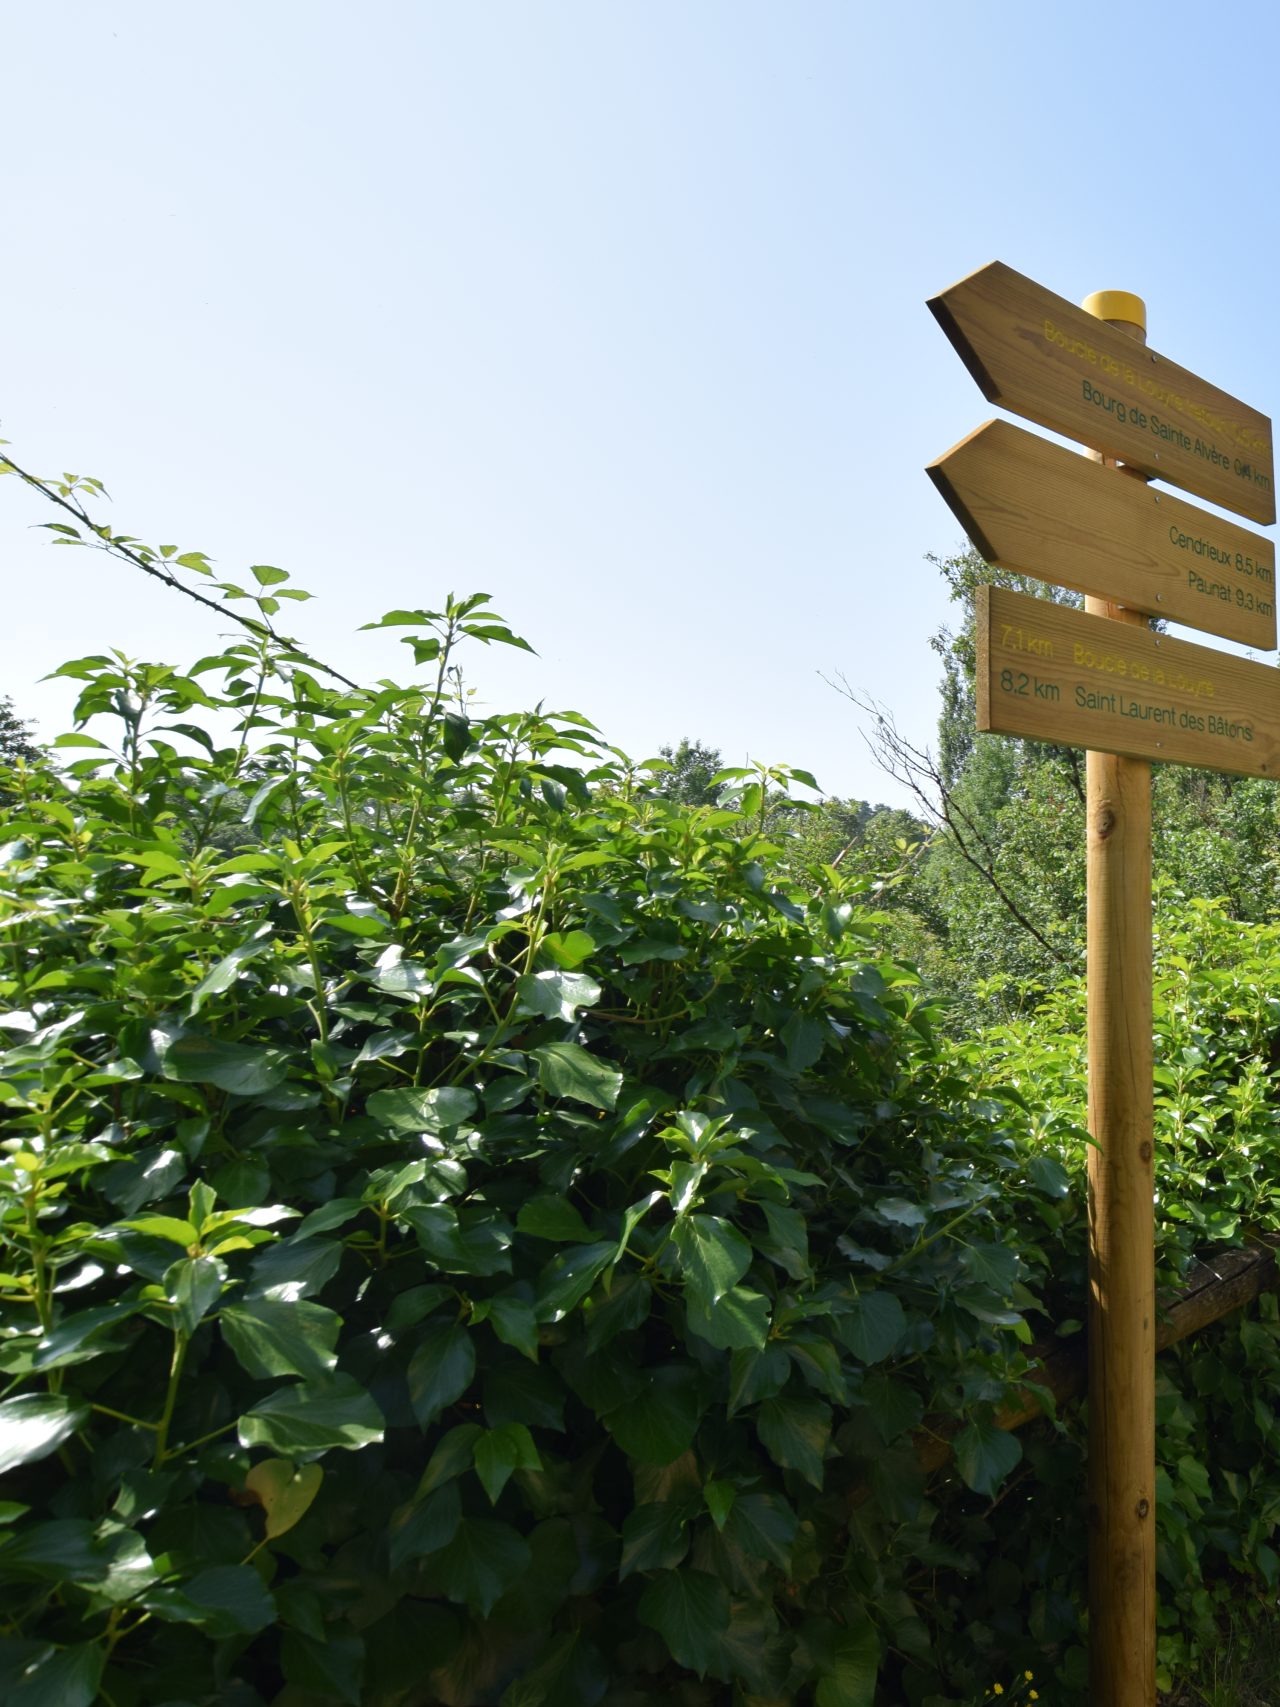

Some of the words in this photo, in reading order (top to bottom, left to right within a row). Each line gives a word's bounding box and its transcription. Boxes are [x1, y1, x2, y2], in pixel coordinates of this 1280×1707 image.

[1082, 379, 1127, 423] Bourg
[1129, 406, 1147, 429] de
[1150, 415, 1191, 451] Sainte
[1193, 438, 1230, 470] Alvère
[1253, 467, 1271, 489] km
[1169, 525, 1231, 567] Cendrieux
[1235, 553, 1254, 576] 8.5
[1255, 561, 1272, 584] km
[1188, 569, 1232, 602] Paunat
[1235, 588, 1254, 611] 9.3
[1256, 597, 1273, 617] km
[1027, 632, 1054, 658] km
[1073, 641, 1127, 676] Boucle
[1129, 661, 1150, 681] de
[1034, 677, 1060, 702] km
[1075, 685, 1116, 714] Saint
[1119, 695, 1176, 727] Laurent
[1179, 711, 1205, 732] des
[1208, 715, 1254, 742] Bâtons
